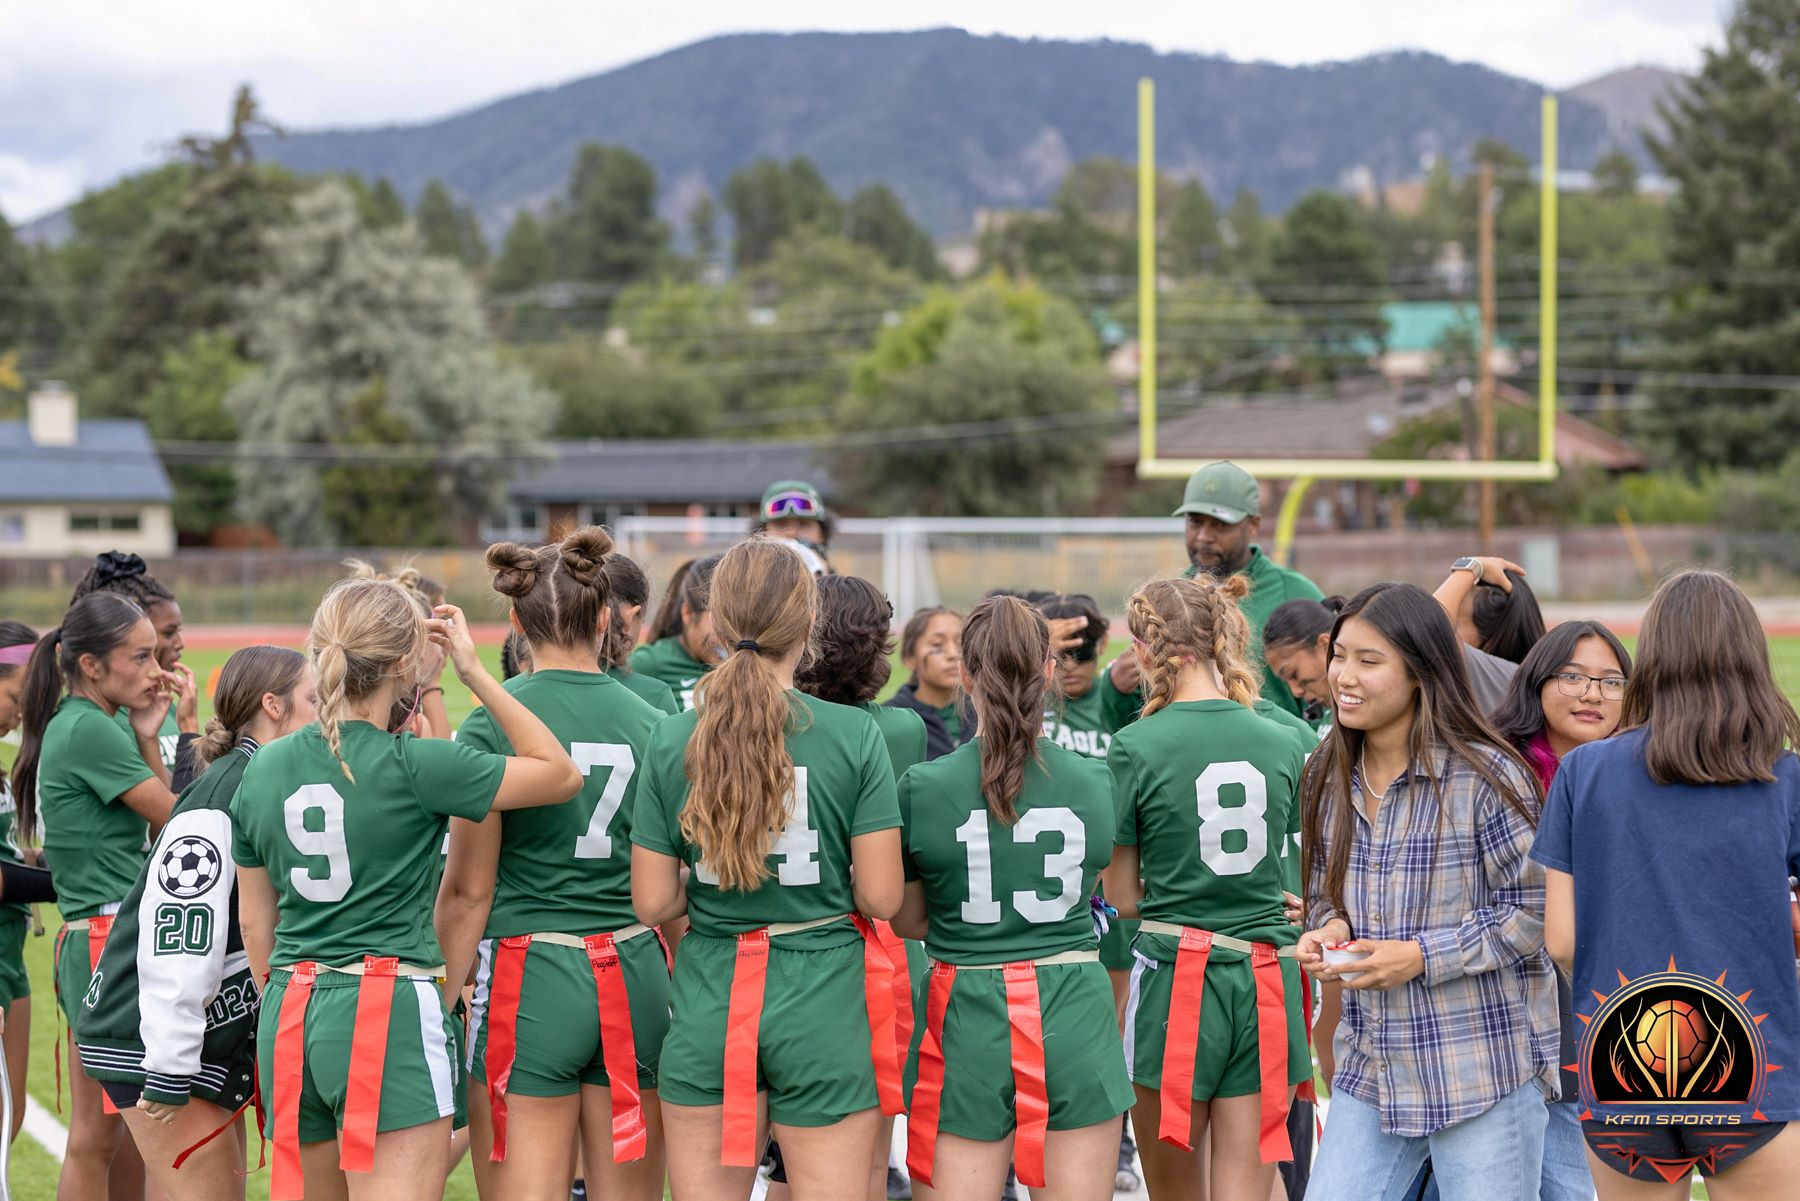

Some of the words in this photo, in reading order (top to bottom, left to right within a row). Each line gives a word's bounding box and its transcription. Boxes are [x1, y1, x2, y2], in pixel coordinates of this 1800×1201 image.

[283, 783, 353, 902] 9
[569, 741, 636, 859] 7
[695, 766, 821, 886] 4
[1195, 760, 1268, 876] 8
[955, 807, 1087, 925] 13
[154, 902, 214, 956] 20
